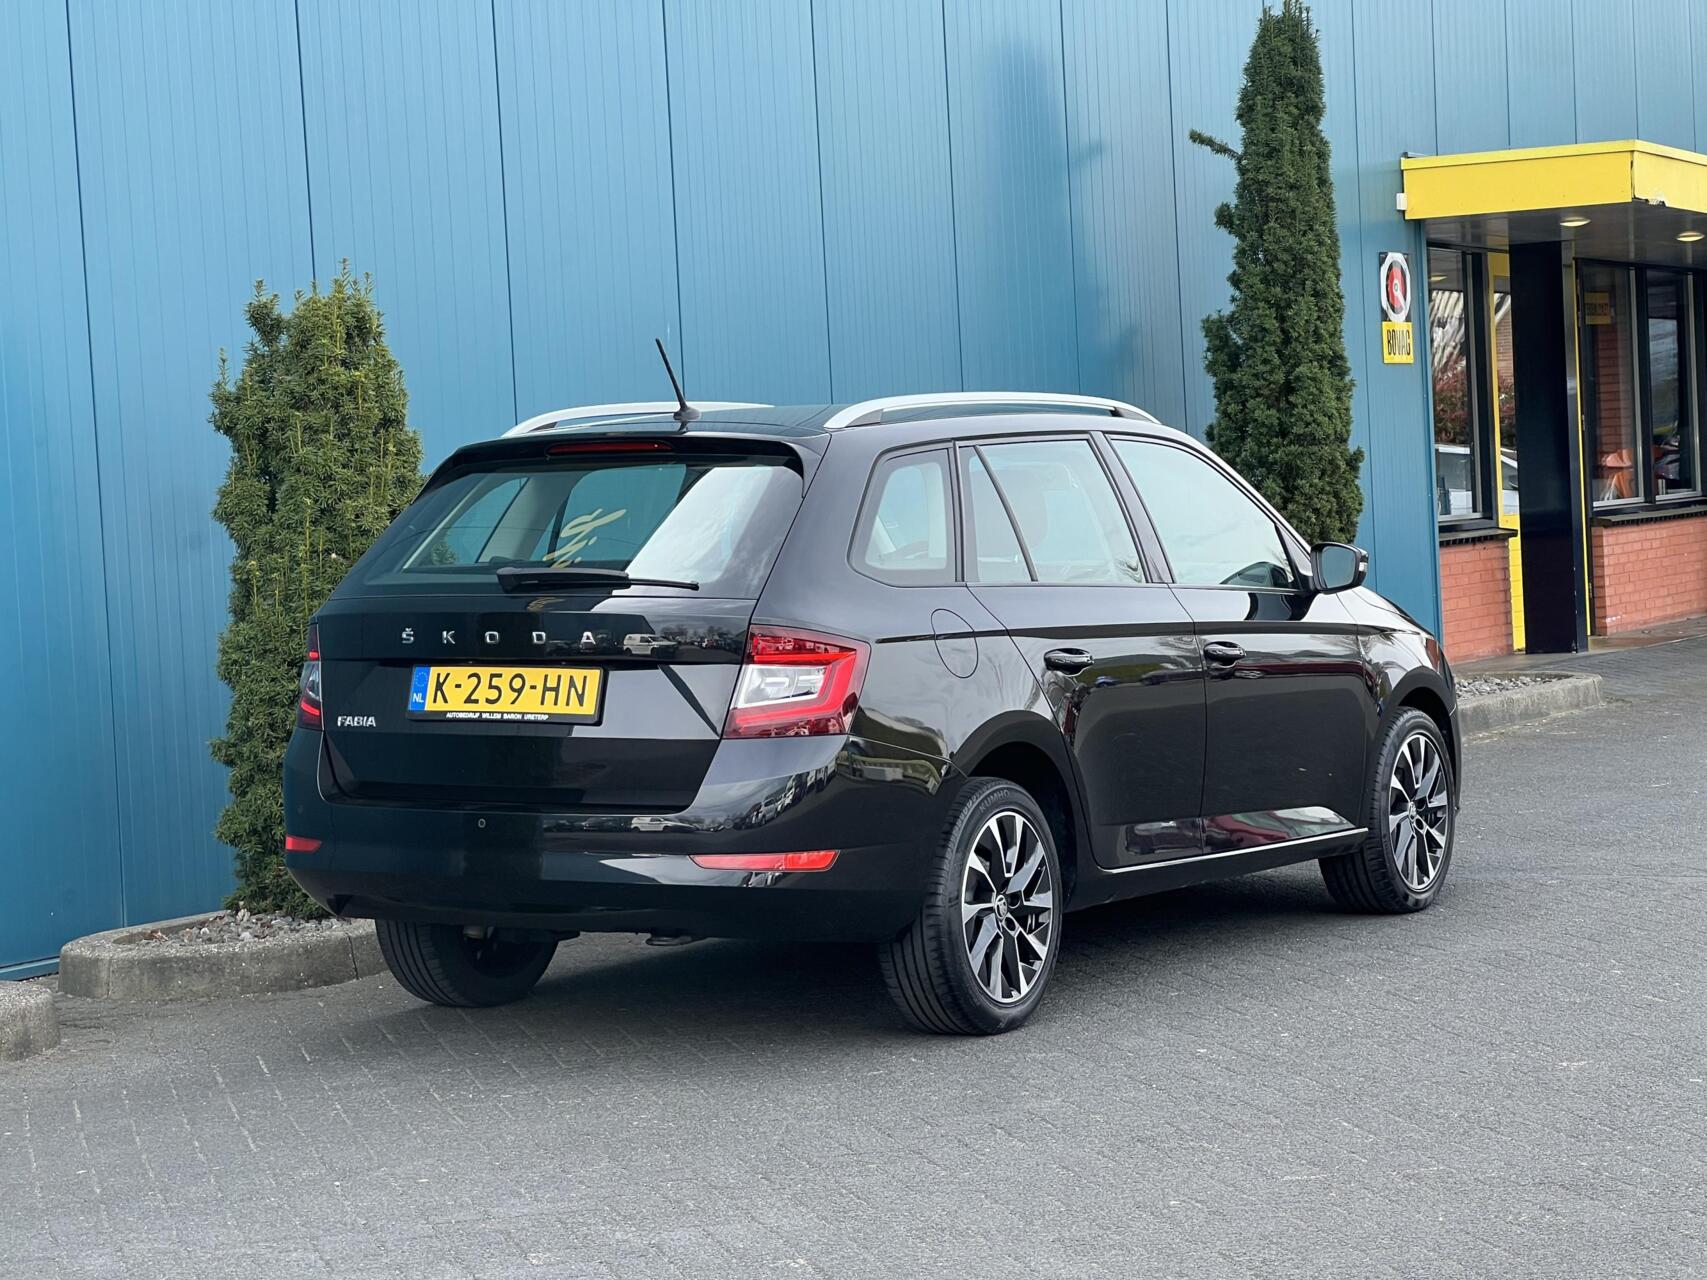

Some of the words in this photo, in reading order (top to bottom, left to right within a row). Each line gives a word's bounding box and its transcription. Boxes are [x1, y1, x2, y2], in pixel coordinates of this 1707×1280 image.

[1387, 329, 1411, 356] BOVAG
[401, 628, 596, 645] ŠKODA
[412, 692, 425, 703] NL
[432, 672, 588, 707] K-259-HN
[337, 715, 376, 727] FABIA
[980, 789, 1010, 813] KUMHO
